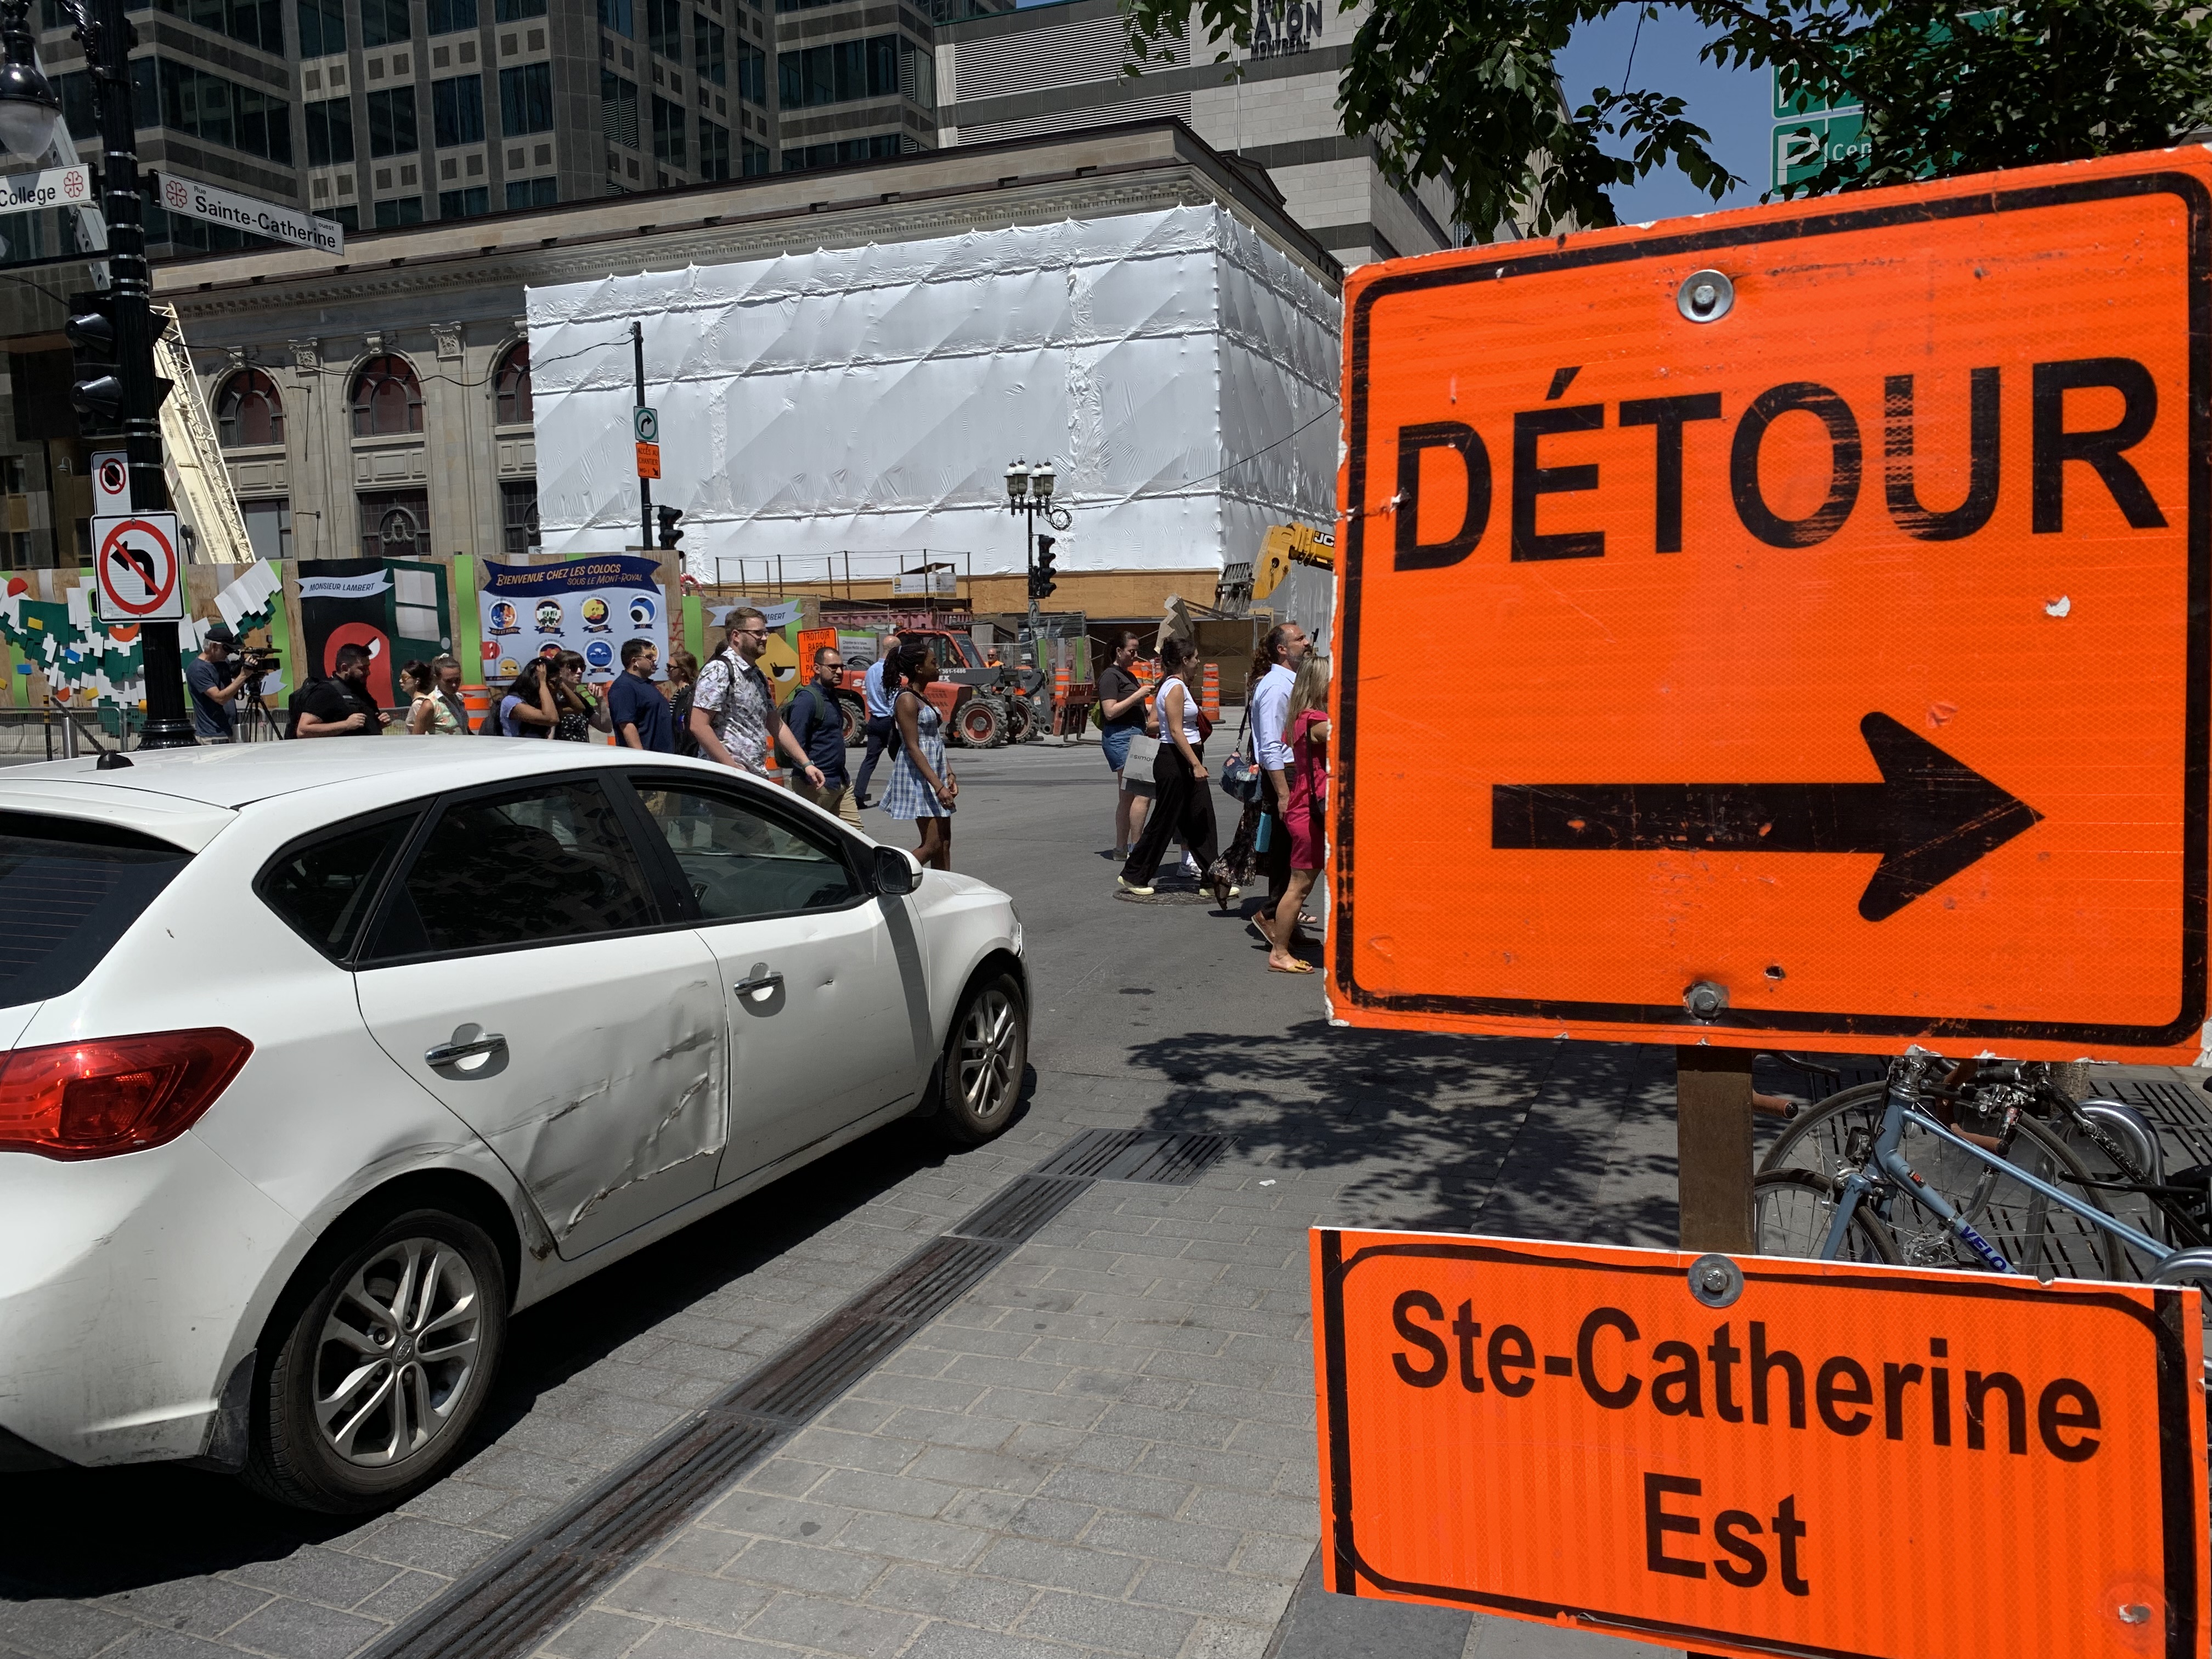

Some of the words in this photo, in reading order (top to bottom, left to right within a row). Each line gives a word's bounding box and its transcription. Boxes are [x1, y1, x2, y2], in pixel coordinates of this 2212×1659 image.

[1245, 0, 1322, 40] ATON
[0, 187, 55, 207] College
[194, 185, 206, 195] Rue
[195, 196, 336, 248] Sainte-Catherine
[318, 222, 335, 231] ouest
[1393, 357, 2169, 572] DÉTOUR
[1314, 533, 1335, 546] JC
[496, 571, 545, 586] BIENVENUE
[546, 568, 569, 580] CHEZ
[570, 566, 585, 577] LES
[587, 563, 622, 574] COLOCS
[567, 577, 585, 585] SOUS
[587, 576, 596, 585] LE
[596, 573, 642, 585] MONT-ROYAL
[309, 583, 341, 591] MONSIEUR
[342, 583, 375, 592] LAMBERT
[765, 612, 786, 620] MBERT
[803, 631, 830, 641] TROTTOIR
[1390, 1289, 2102, 1464] Ste-Catherine
[1644, 1472, 1809, 1596] Est
